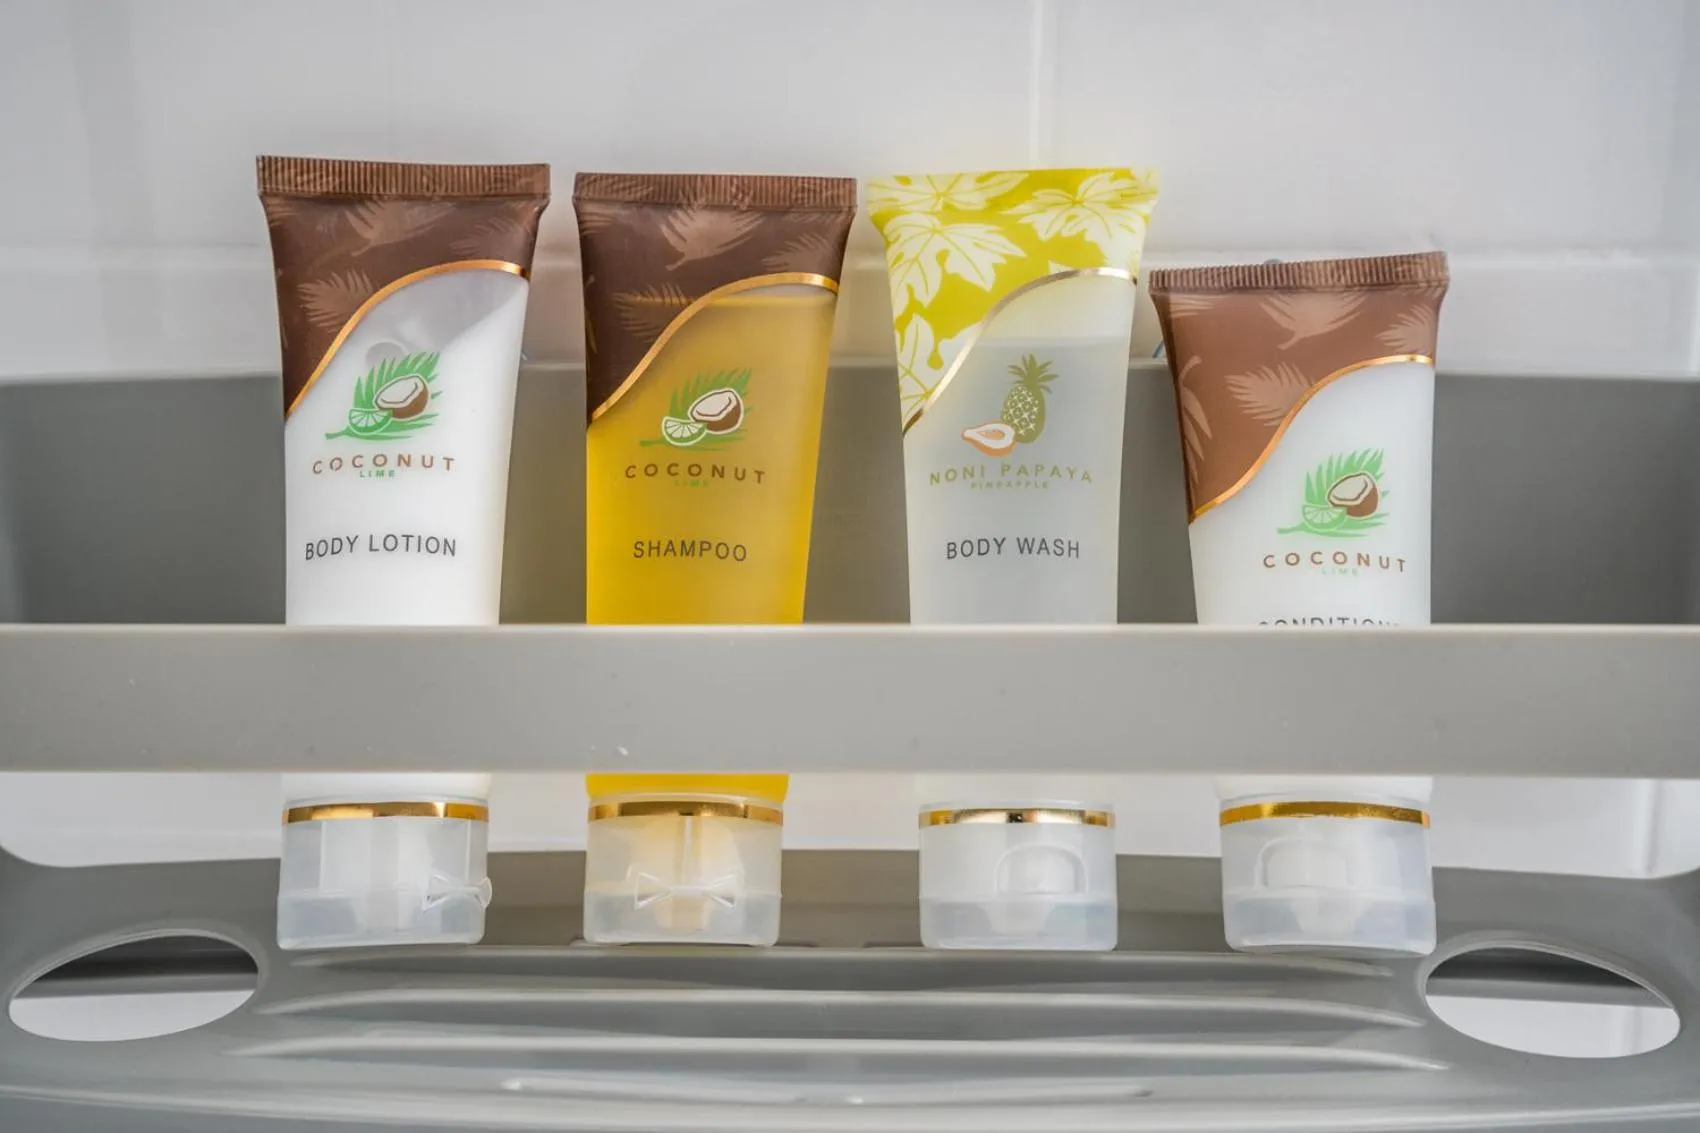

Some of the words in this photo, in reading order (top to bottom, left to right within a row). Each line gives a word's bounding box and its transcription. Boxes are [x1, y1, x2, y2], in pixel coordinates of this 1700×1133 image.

[312, 453, 456, 475] COCONUT
[359, 469, 396, 478] LIME
[625, 462, 766, 484] COCONUT
[929, 464, 986, 486] NONI
[1001, 464, 1093, 483] PAPAYA
[305, 534, 359, 561] BODY
[368, 533, 456, 557] LOTION
[633, 540, 748, 562] SHAMPOO
[946, 536, 1007, 560] BODY
[1015, 536, 1080, 559] WASH
[1263, 551, 1407, 573] COCONUT
